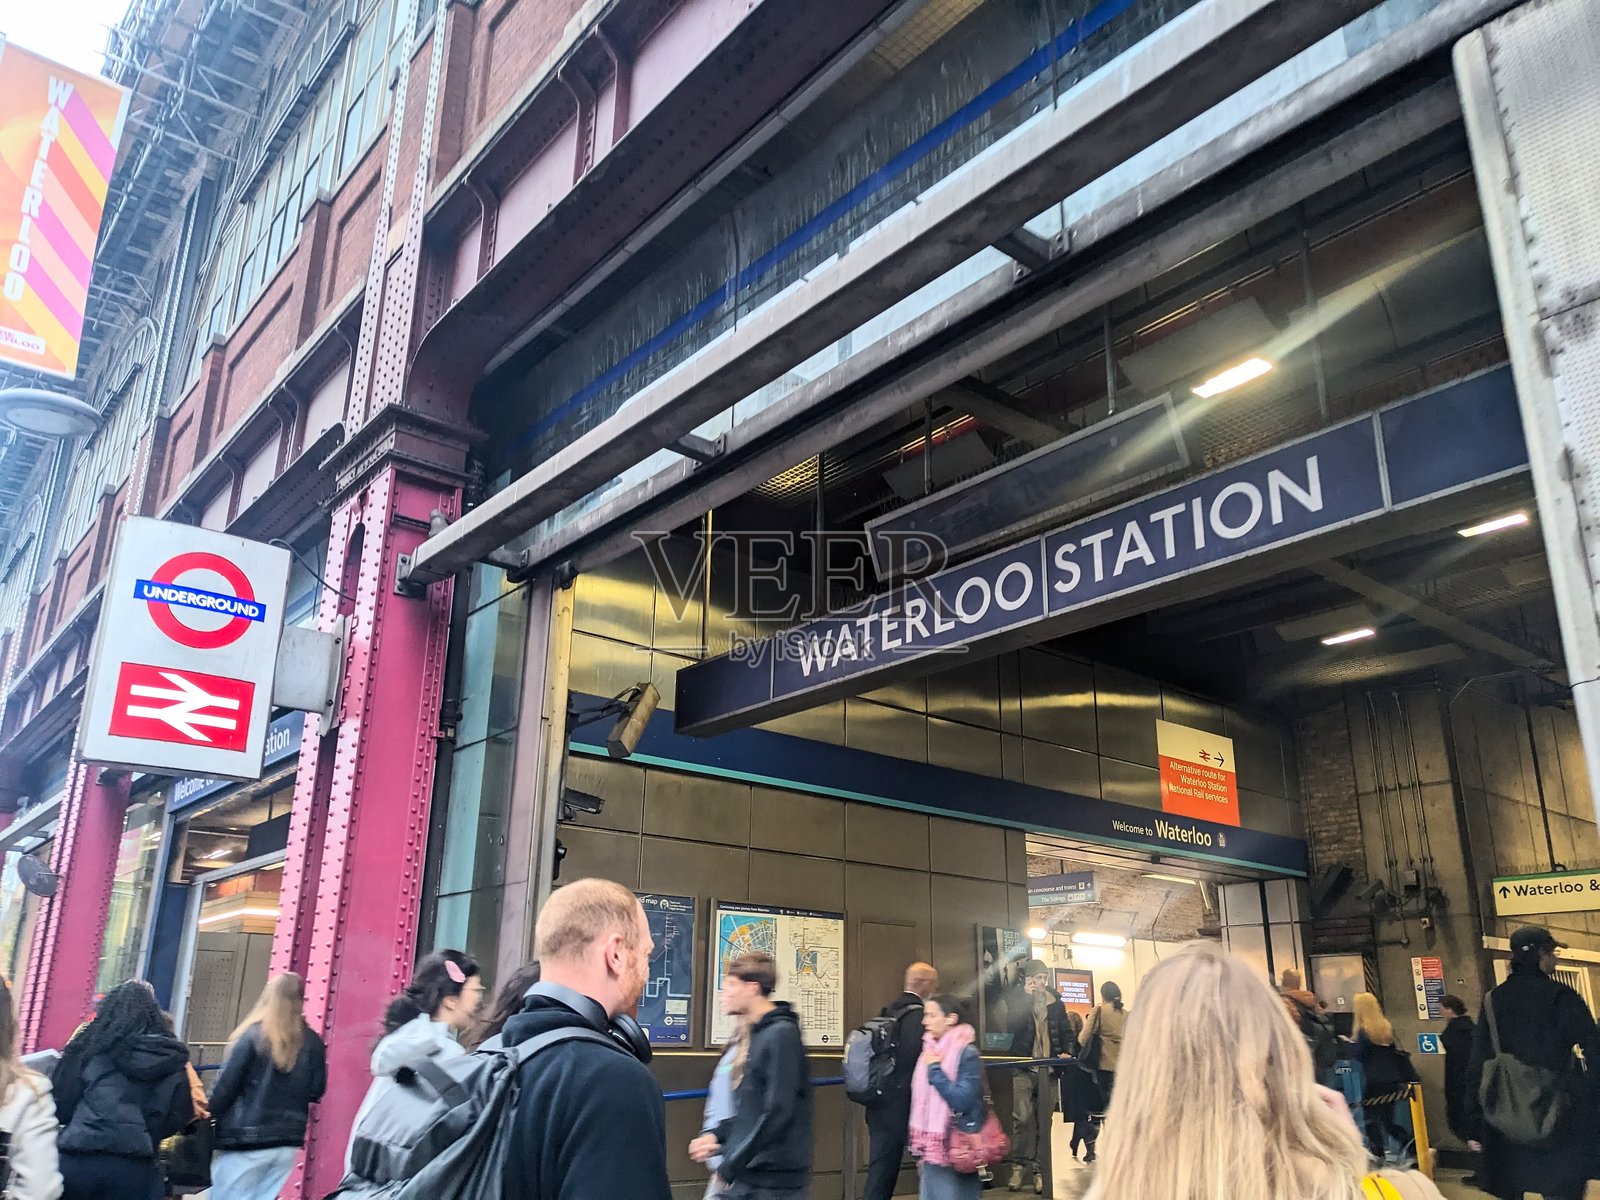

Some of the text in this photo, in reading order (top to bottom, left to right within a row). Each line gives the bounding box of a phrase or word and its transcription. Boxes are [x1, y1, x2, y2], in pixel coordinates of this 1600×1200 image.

[3, 75, 75, 302] WATERLOO
[1054, 455, 1323, 593] STATION
[143, 584, 259, 617] UNDERGROUND
[798, 561, 1034, 677] WATERLOO
[265, 728, 290, 756] ation
[1169, 760, 1226, 781] Alternative route for
[1180, 774, 1228, 792] Waterloo Station
[1168, 782, 1228, 804] National Rail services
[1112, 819, 1212, 847] Welcome to Waterloo
[1513, 879, 1600, 897] Waterloo &
